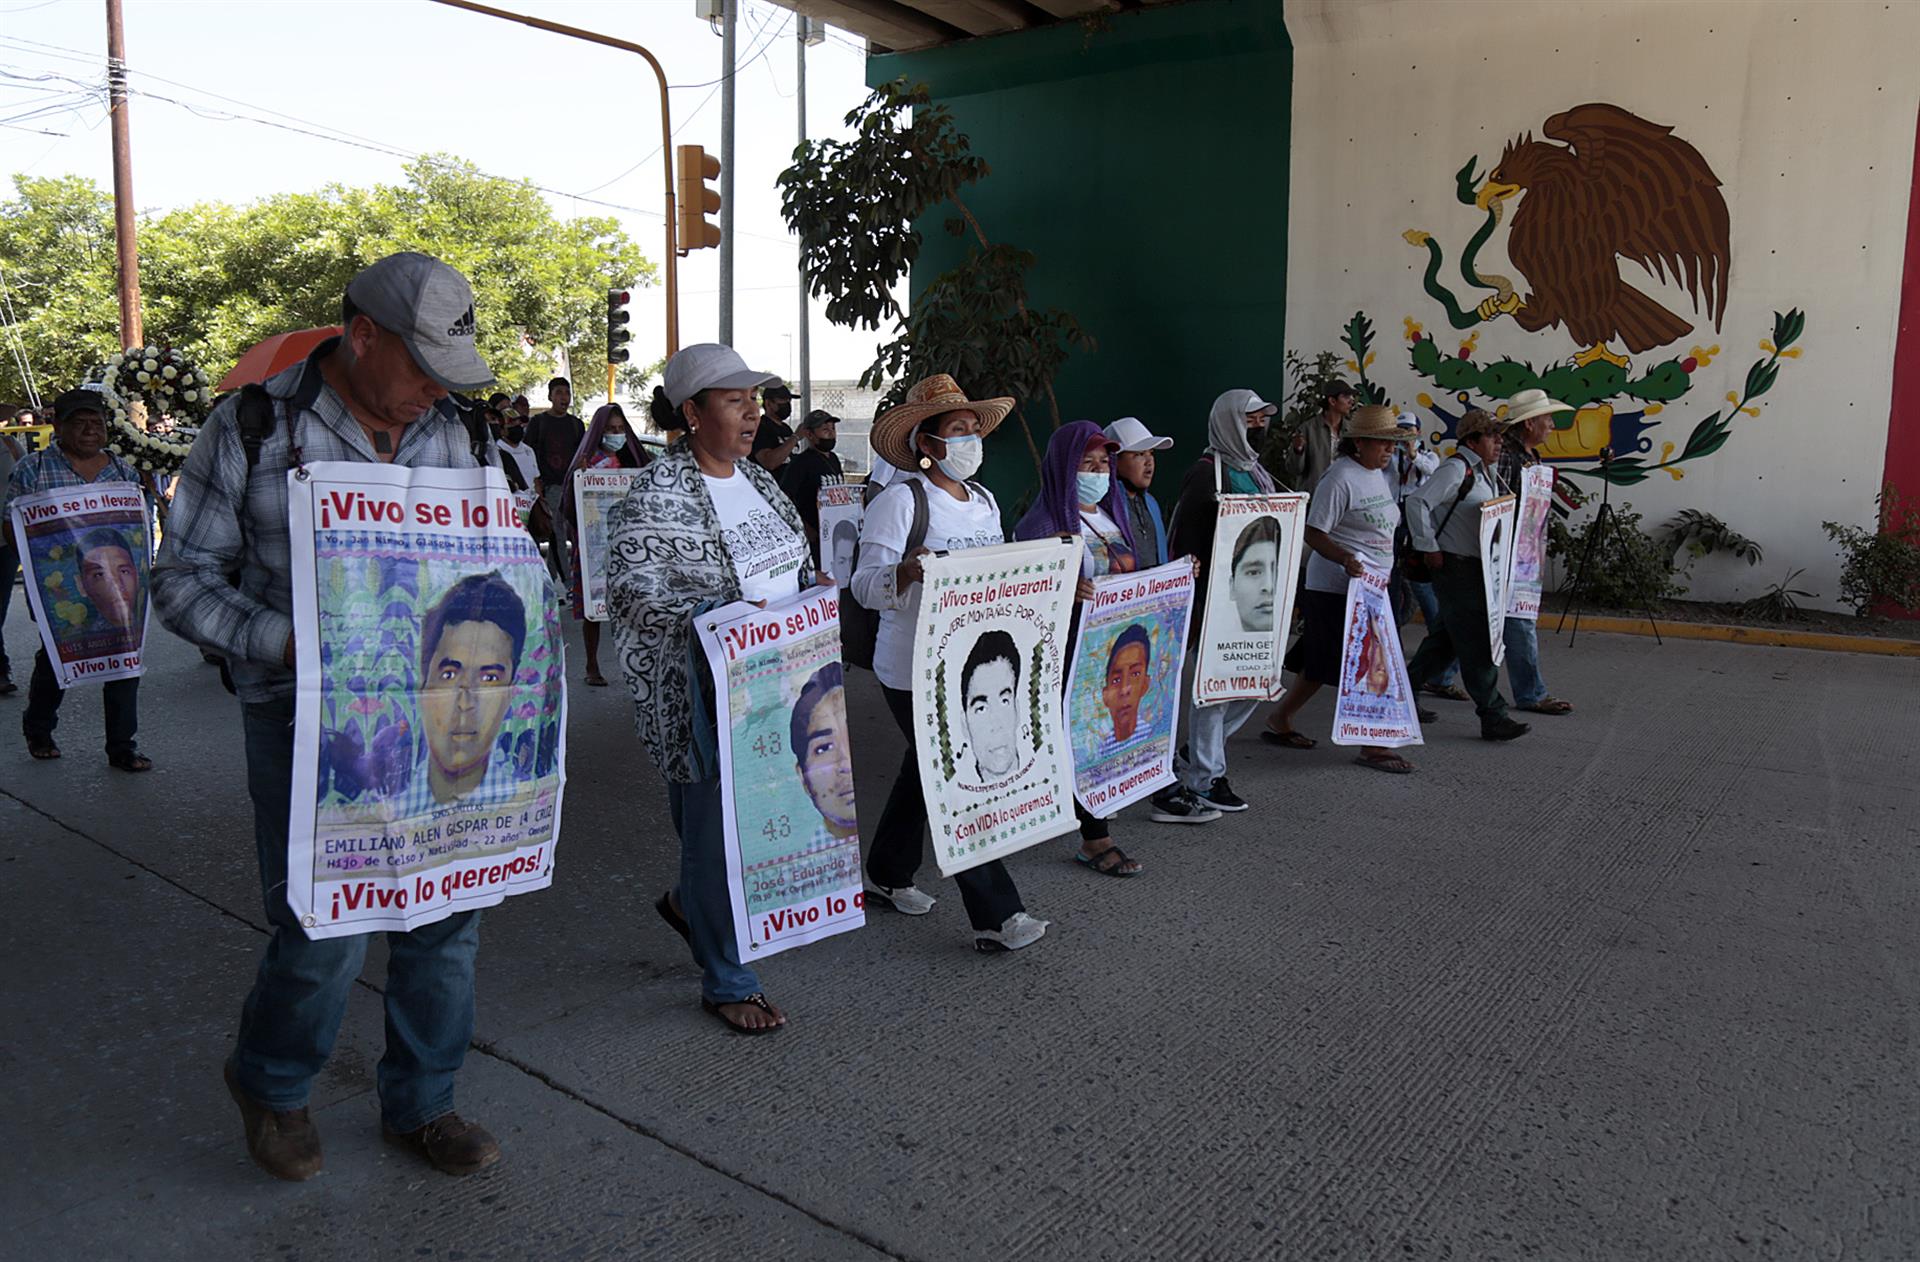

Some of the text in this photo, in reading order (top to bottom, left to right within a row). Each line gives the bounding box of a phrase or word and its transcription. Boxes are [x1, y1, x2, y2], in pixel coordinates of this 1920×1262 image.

[583, 476, 605, 487] ¡Vivo
[608, 477, 618, 486] se
[619, 475, 628, 487] lo
[23, 501, 58, 525] ¡Vivo
[63, 500, 80, 512] se
[84, 497, 97, 510] lo
[321, 491, 528, 532] ¡Vivo se lo lle
[595, 603, 607, 615] ¡Co
[939, 576, 1053, 613] ¡Vivo se lo llevaron!
[1090, 590, 1118, 614] ¡Vivo
[1120, 588, 1133, 602] se
[1136, 582, 1146, 598] lo
[1148, 572, 1192, 594] llevaron!
[1014, 603, 1035, 621] POR
[724, 621, 780, 661] ¡Vivo
[786, 613, 805, 636] se
[803, 605, 819, 628] lo
[1217, 639, 1254, 650] MARTÍN
[72, 660, 105, 678] ¡Vivo
[108, 657, 120, 670] lo
[1204, 678, 1226, 695] ¡Con
[1230, 676, 1256, 690] VIDA
[752, 731, 782, 759] 43
[1341, 723, 1359, 738] ¡Vivo
[1360, 725, 1368, 736] lo
[1107, 783, 1117, 799] lo
[1118, 760, 1164, 796] queremos!
[325, 835, 406, 854] EMILIANO
[413, 826, 441, 846] ALEN
[446, 819, 488, 837] GSPAR
[495, 816, 513, 829] DE
[762, 814, 792, 842] 43
[955, 791, 1054, 844] ¡Con VIDA lo queremos!
[327, 858, 357, 871] Hijo
[364, 856, 380, 866] de
[386, 854, 416, 866] Celso
[418, 851, 425, 862] y
[484, 835, 496, 845] 22
[753, 873, 785, 893] José
[792, 857, 846, 881] Eduardo
[331, 882, 408, 920] ¡Vivo
[415, 876, 435, 905] lo
[762, 905, 819, 941] ¡Vivo
[826, 896, 847, 917] lo
